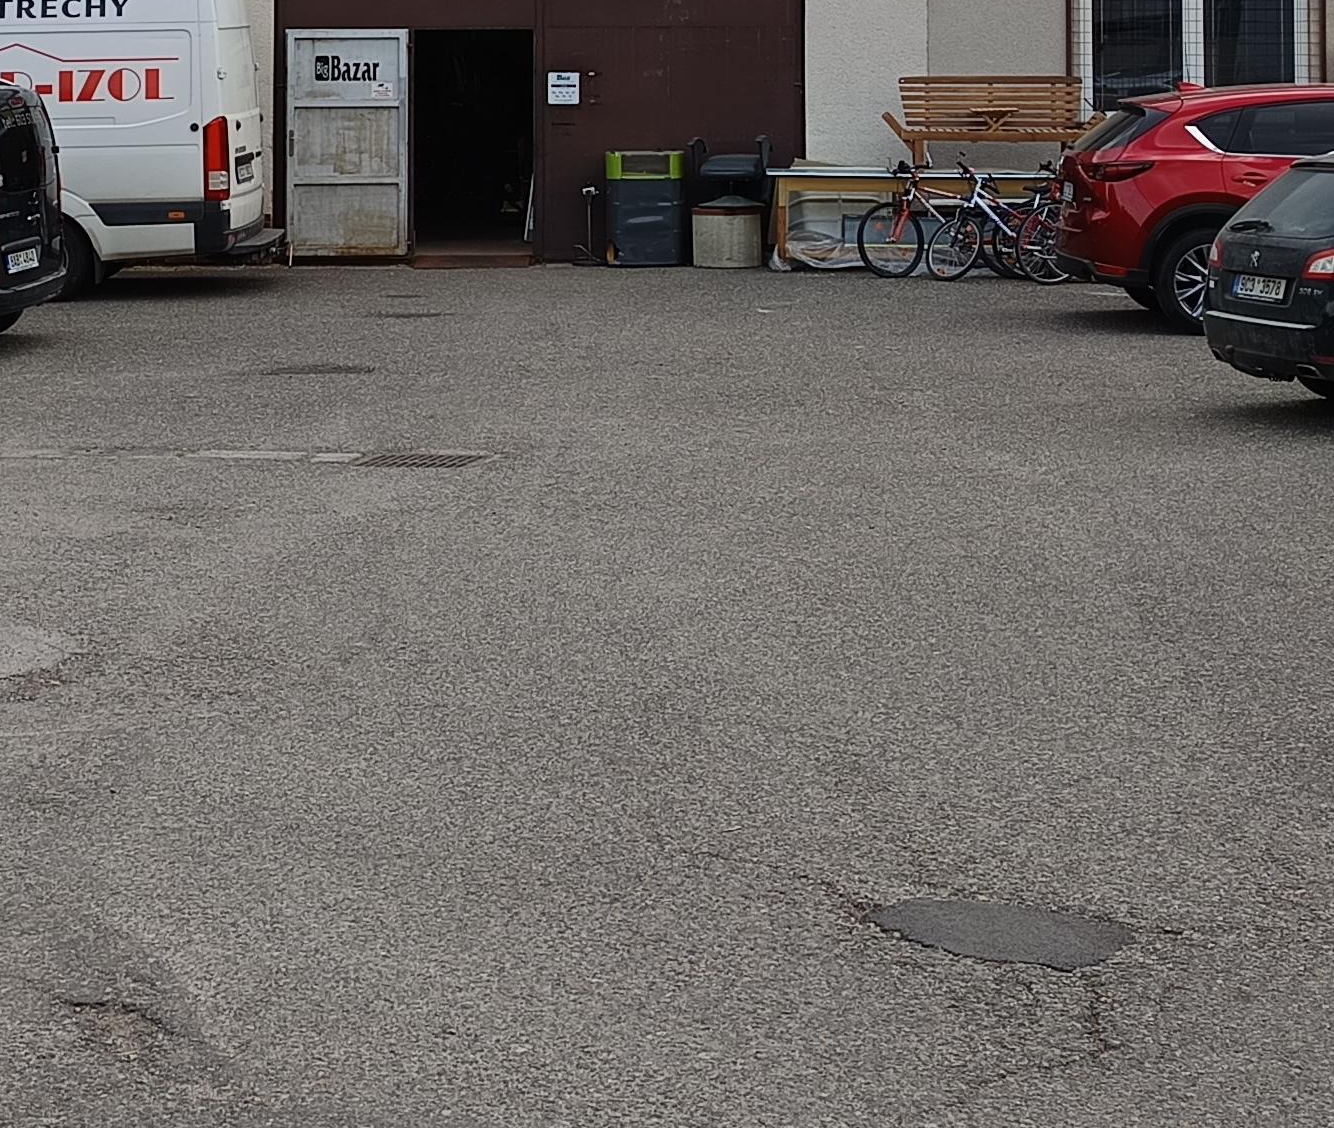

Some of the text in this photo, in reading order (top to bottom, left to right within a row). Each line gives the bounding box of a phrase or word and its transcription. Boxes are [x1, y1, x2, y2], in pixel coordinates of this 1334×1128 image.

[316, 55, 380, 81] Big Bazar
[1240, 276, 1283, 296] 9C3 3578
